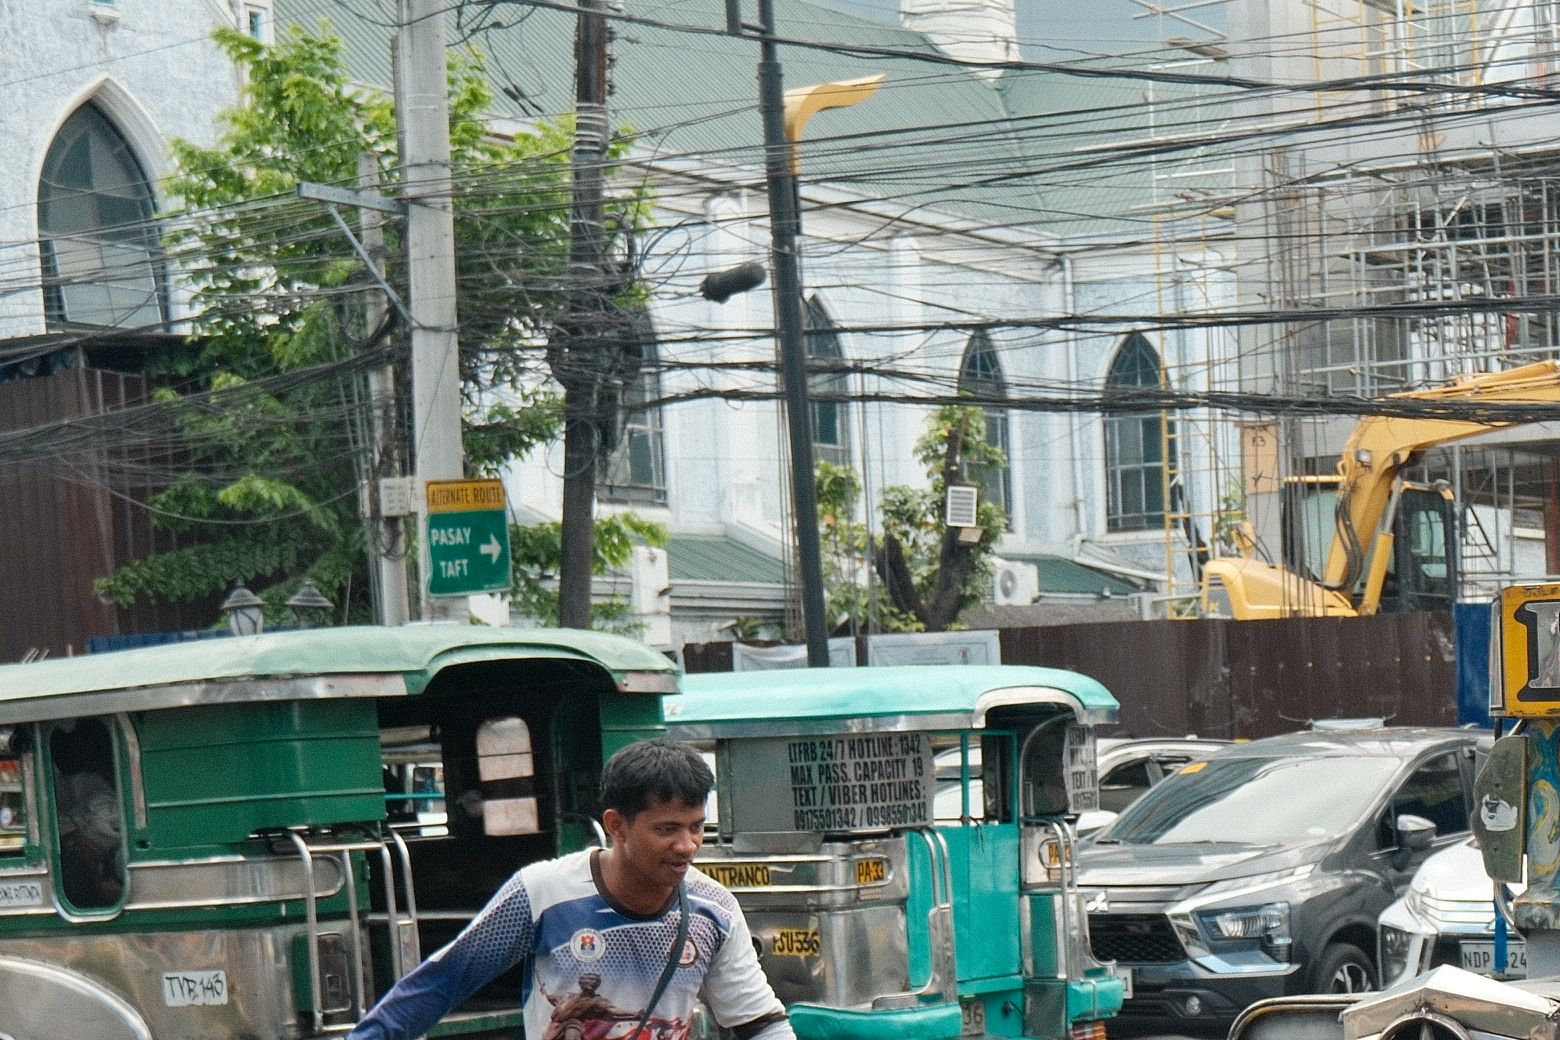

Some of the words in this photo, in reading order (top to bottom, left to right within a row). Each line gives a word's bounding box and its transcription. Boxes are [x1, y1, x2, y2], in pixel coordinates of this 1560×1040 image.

[431, 488, 468, 506] ALTERNATE
[473, 486, 501, 503] ROUTE
[430, 527, 472, 546] PASAY
[439, 559, 469, 578] TAFT
[788, 741, 818, 763] LTFRB
[820, 739, 846, 761] 24/7
[900, 733, 921, 755] 1342
[790, 765, 814, 785] MAX
[818, 762, 852, 784] PASS.
[854, 758, 906, 782] CAPACITY
[912, 757, 924, 777] 19
[792, 785, 817, 807] TEXT
[820, 785, 826, 806] /
[829, 784, 867, 805] VIBER
[1463, 951, 1490, 969] NDP
